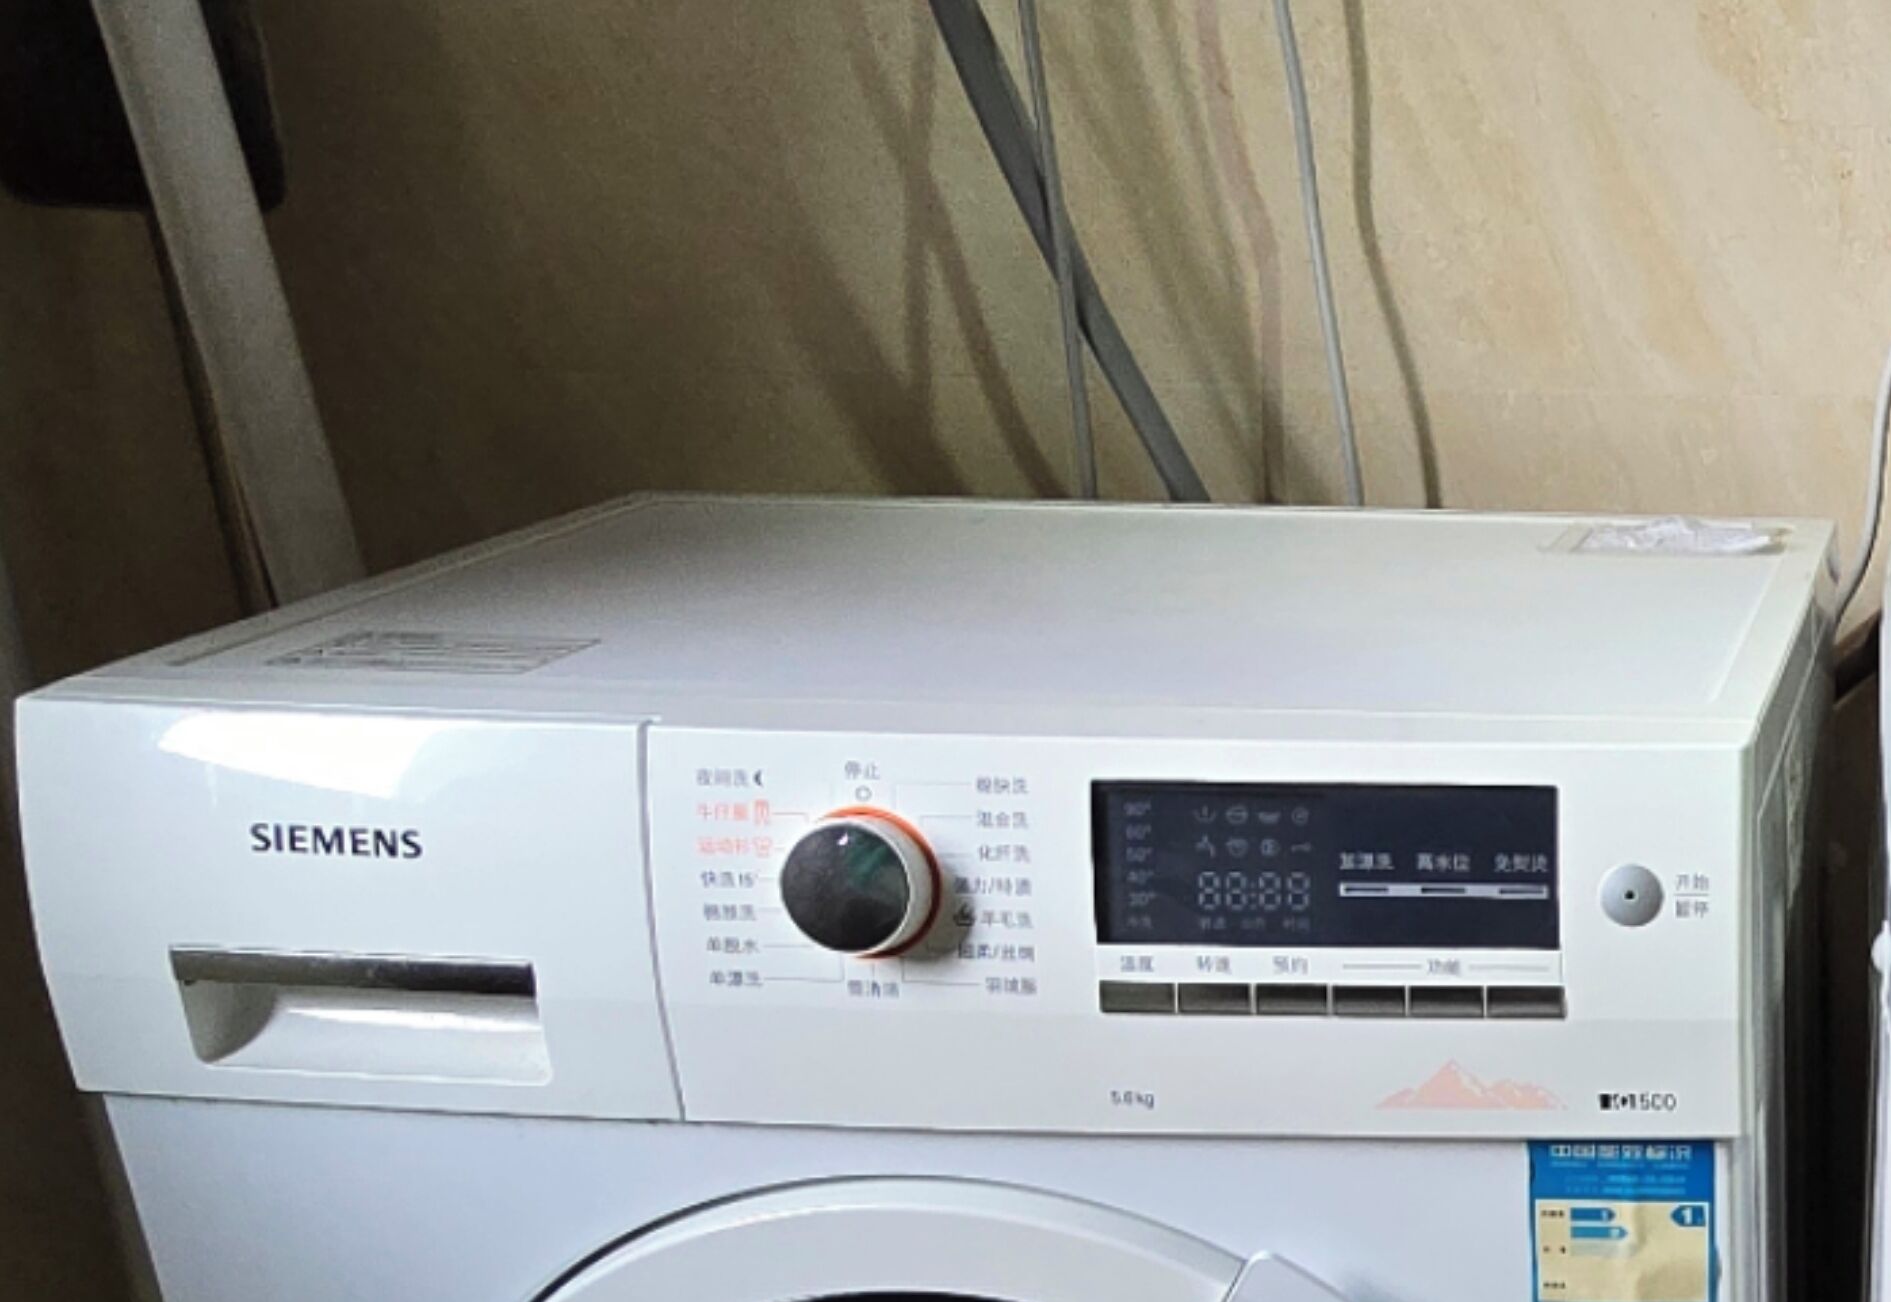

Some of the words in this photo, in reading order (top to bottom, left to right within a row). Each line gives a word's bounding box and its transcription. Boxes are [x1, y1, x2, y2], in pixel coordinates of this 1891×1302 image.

[844, 761, 881, 780] 停止
[976, 812, 1029, 830] 混合洗
[250, 822, 423, 860] SIEMENS
[978, 845, 1031, 863] 化纤洗
[1416, 852, 1471, 872] 高水位
[1675, 872, 1710, 891] 开始
[1675, 899, 1710, 919] 暂停
[979, 911, 1033, 929] 羊毛洗
[1120, 955, 1155, 973] 温度
[1196, 955, 1232, 975] 转速
[1273, 956, 1309, 976] 预约
[1427, 957, 1462, 977] 功能
